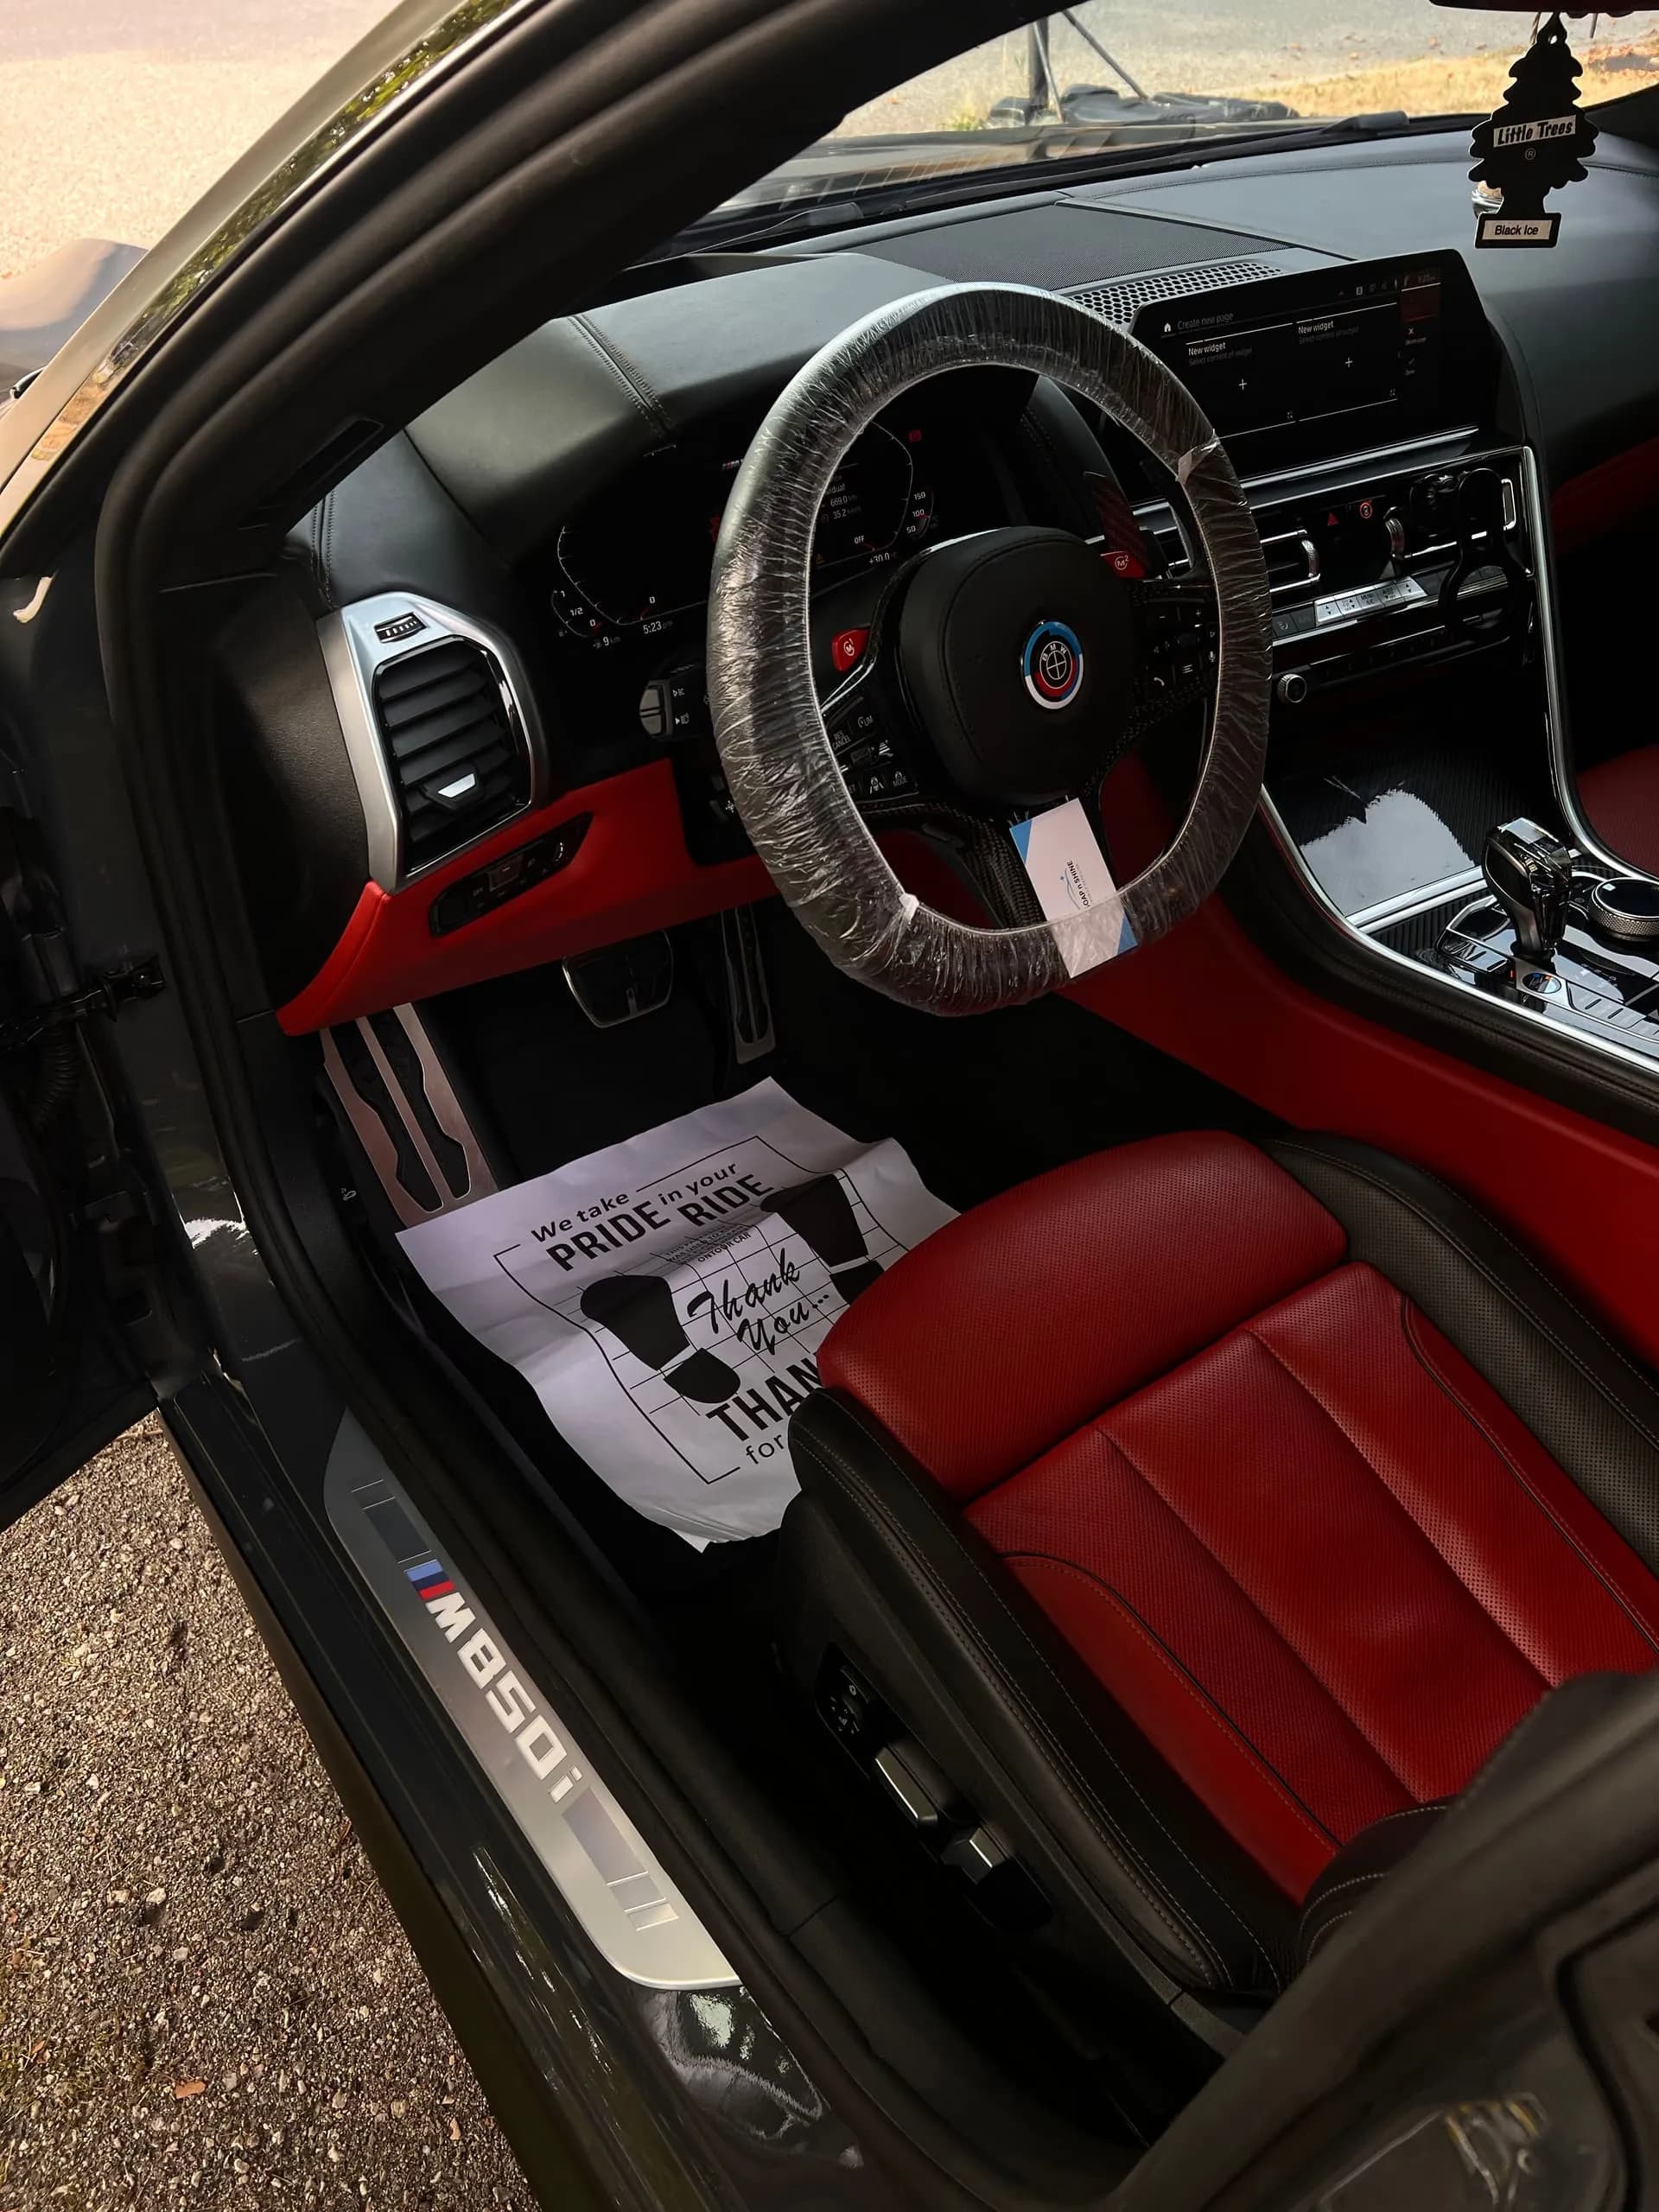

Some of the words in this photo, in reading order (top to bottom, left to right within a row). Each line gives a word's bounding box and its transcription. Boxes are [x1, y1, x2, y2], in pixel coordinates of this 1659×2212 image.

[1497, 124, 1534, 145] Little
[1537, 121, 1573, 139] Trees
[1495, 225, 1522, 236] Black
[1524, 225, 1538, 236] Ice
[1177, 318, 1200, 330] Create
[1202, 317, 1215, 326] new
[1216, 312, 1234, 325] page
[1298, 326, 1312, 335] New
[1313, 321, 1334, 333] widget
[1188, 346, 1203, 356] New
[1204, 342, 1226, 353] widget
[913, 491, 925, 500] 150
[912, 509, 925, 518] 100
[906, 525, 916, 534] 50
[569, 607, 584, 617] 1/2
[643, 621, 662, 635] 5:23
[1042, 643, 1067, 662] BMW
[832, 734, 851, 750] CANCEL
[1067, 861, 1079, 884] SHINE
[658, 1190, 683, 1205] in
[685, 1163, 738, 1196] your
[531, 1219, 573, 1243] We
[576, 1193, 629, 1223] take
[546, 1201, 671, 1272] PRIDE
[677, 1174, 774, 1227] RIDE
[687, 1248, 800, 1333] Thank
[707, 1353, 821, 1441] THAN
[746, 1434, 785, 1465] for
[425, 1592, 583, 1803] M850i
